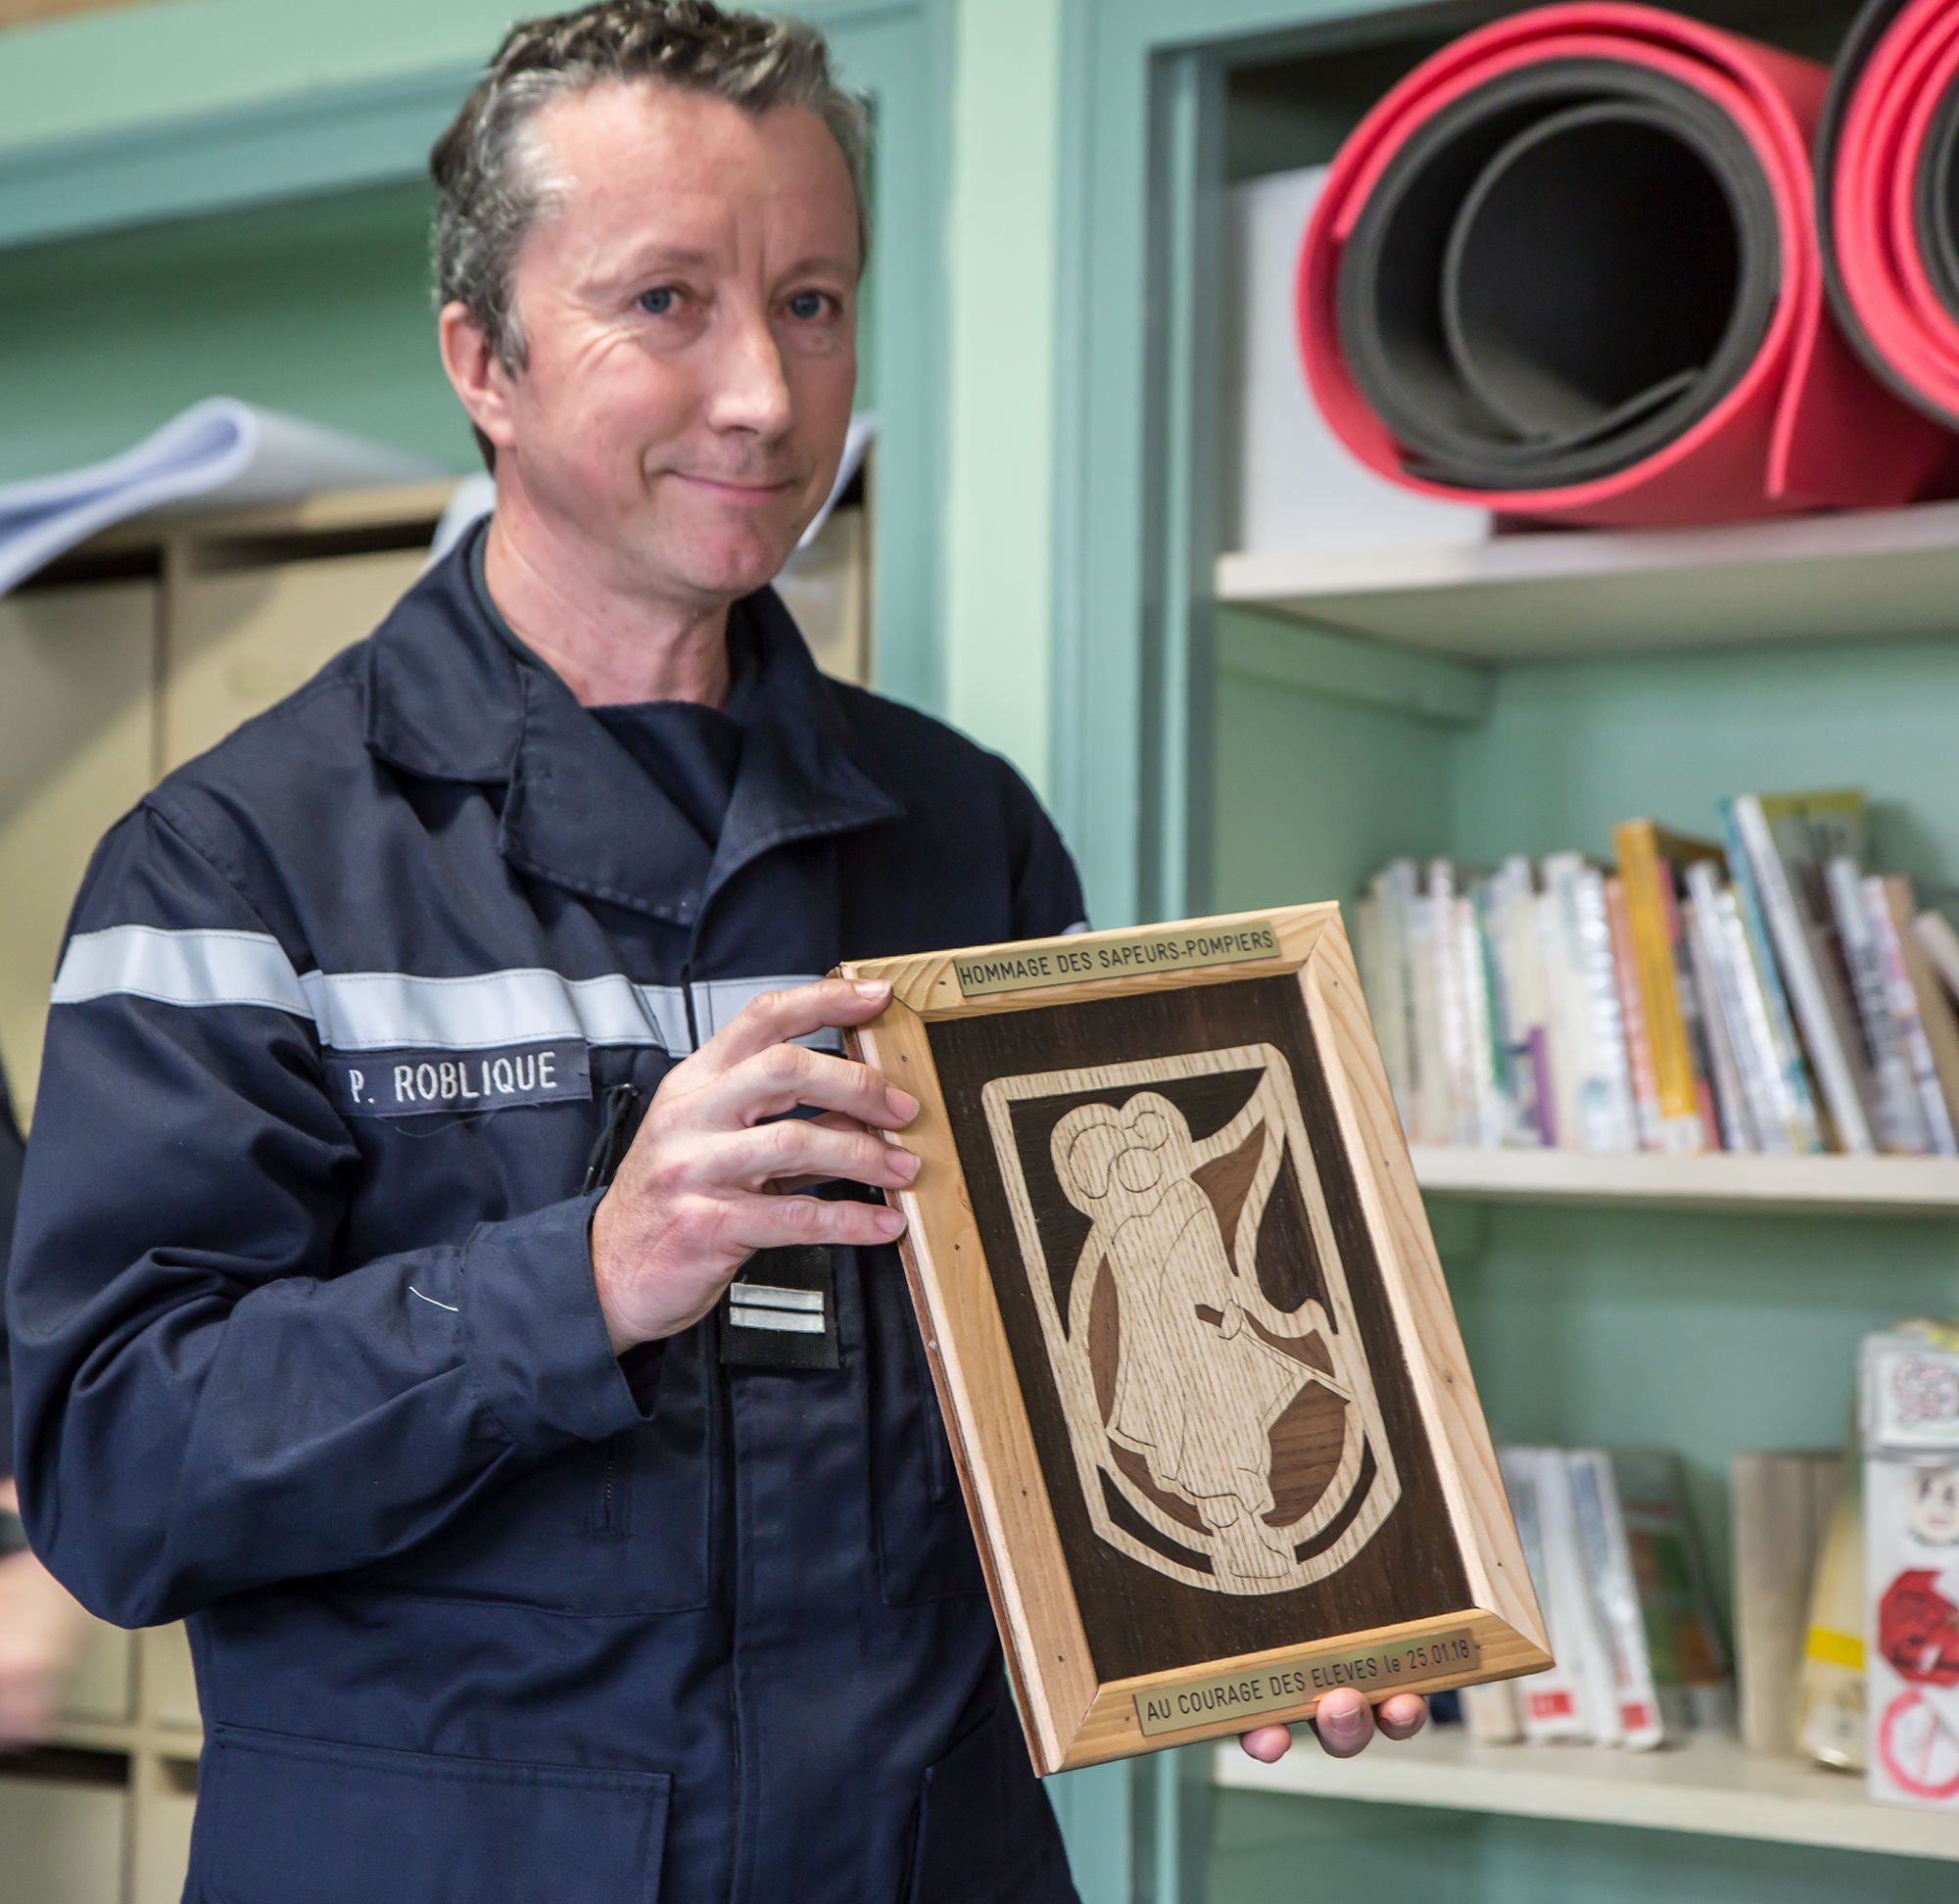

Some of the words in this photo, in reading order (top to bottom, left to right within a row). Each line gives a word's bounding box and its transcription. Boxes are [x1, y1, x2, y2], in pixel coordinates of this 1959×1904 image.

[959, 956, 1052, 986] HOMMAGE
[1057, 951, 1093, 974] DES
[1098, 929, 1274, 969] SAPEURS-POMPIERS
[349, 1069, 375, 1104] P.
[393, 1051, 558, 1103] ROBLIQUE
[1146, 1698, 1172, 1723] AU
[1177, 1680, 1264, 1715] COURAGE
[1271, 1671, 1307, 1696] DES
[1311, 1656, 1379, 1689] ELEVES
[1383, 1654, 1402, 1675] le
[1406, 1639, 1470, 1670] 25.01.18
